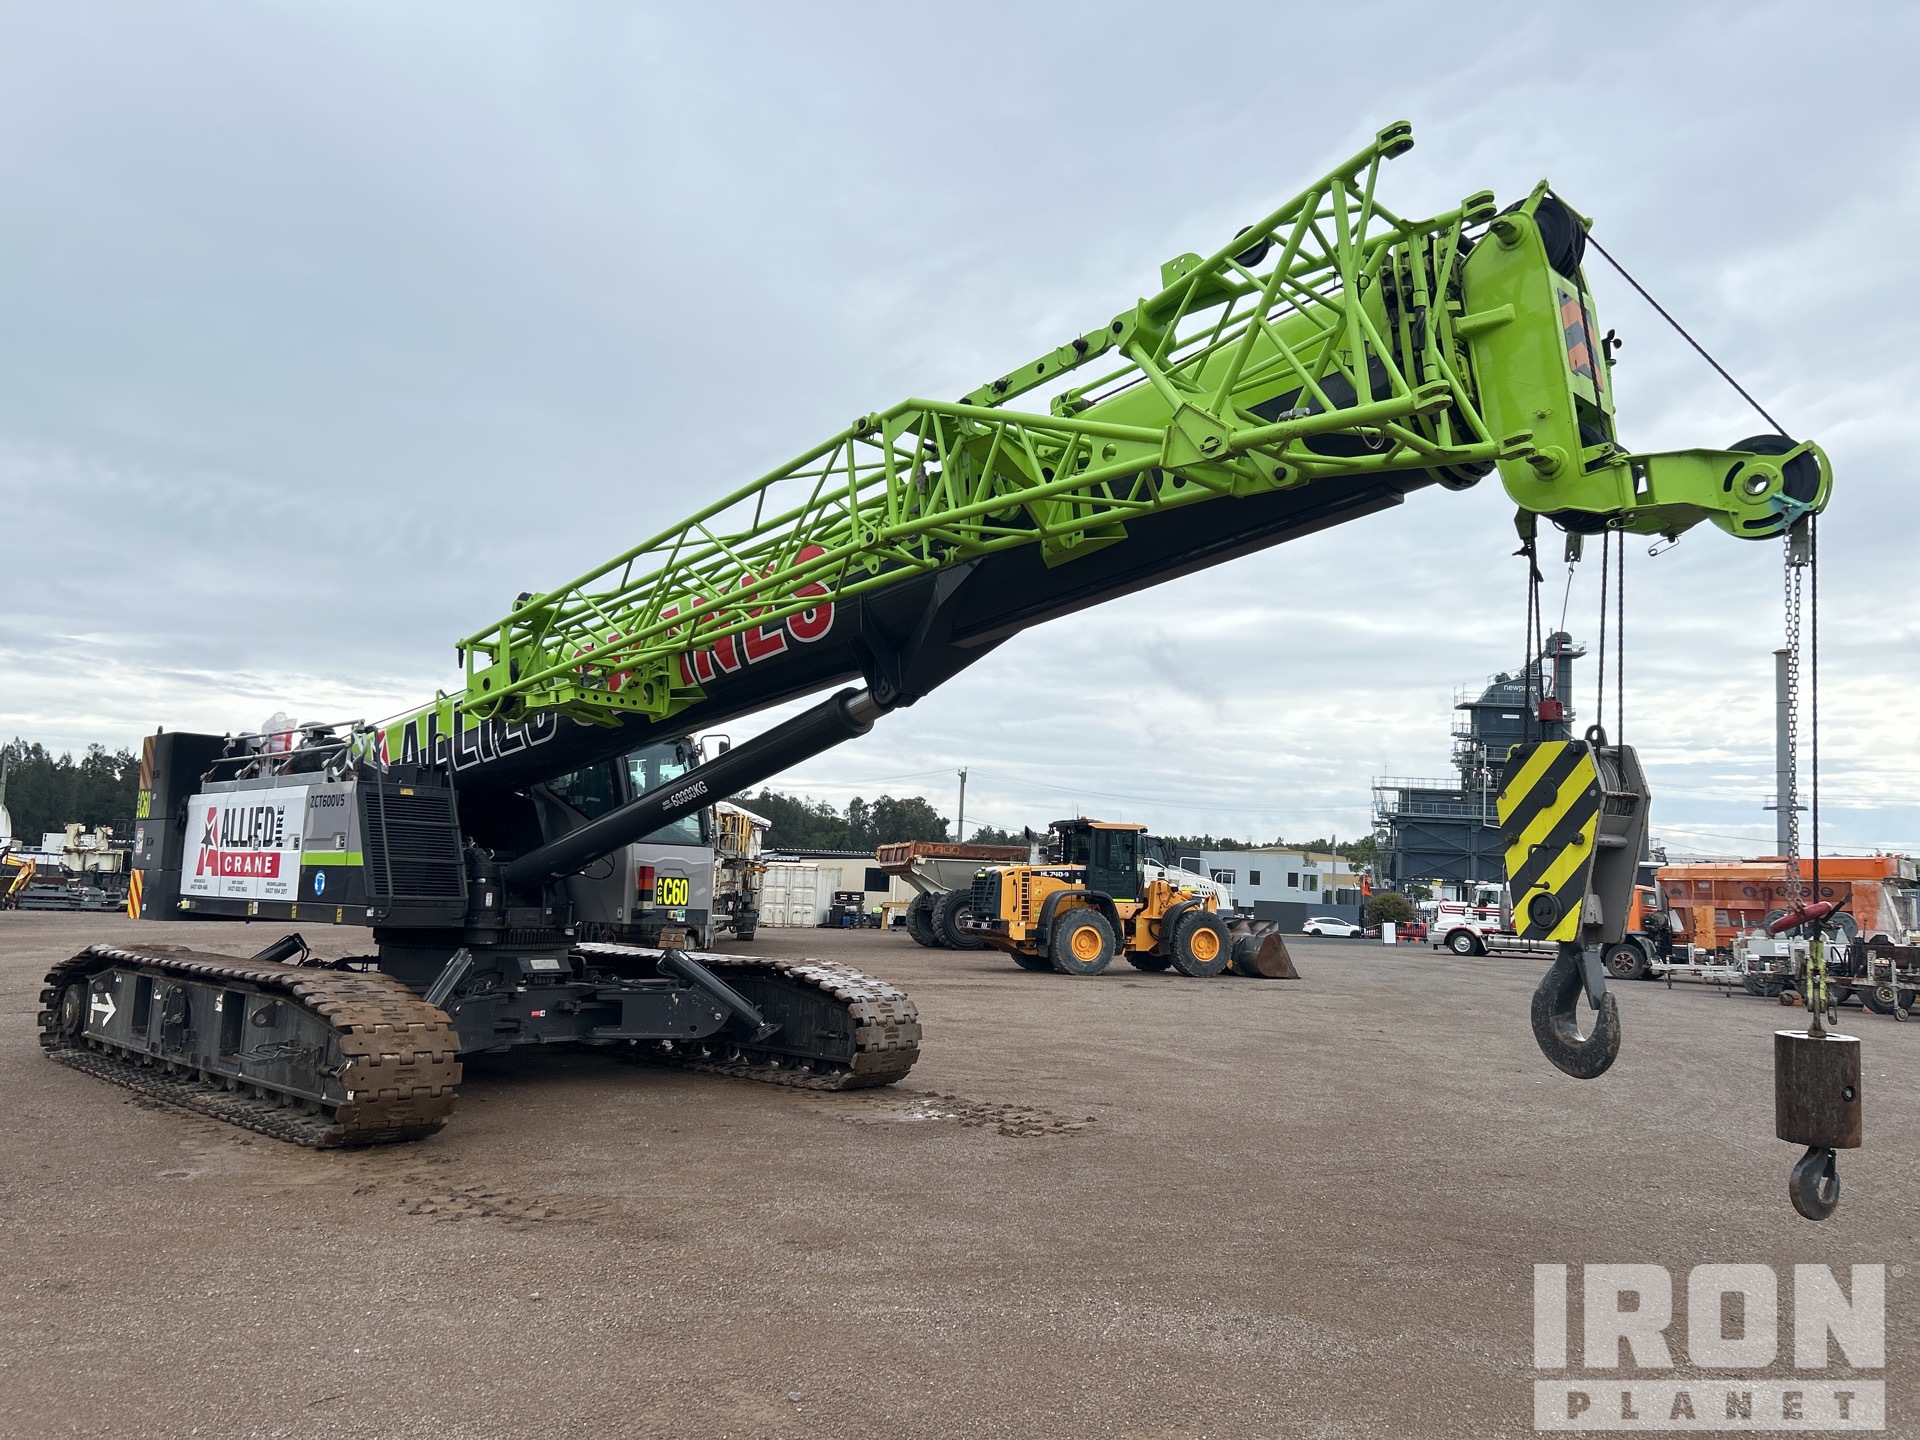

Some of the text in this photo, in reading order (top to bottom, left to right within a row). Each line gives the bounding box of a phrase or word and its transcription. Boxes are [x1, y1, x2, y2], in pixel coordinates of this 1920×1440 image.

[1503, 684, 1537, 692] newpve
[671, 780, 709, 807] 60000KG
[219, 806, 275, 848] ALLIED
[275, 805, 285, 848] HIRE
[224, 856, 273, 874] CRANE
[663, 877, 689, 906] C60
